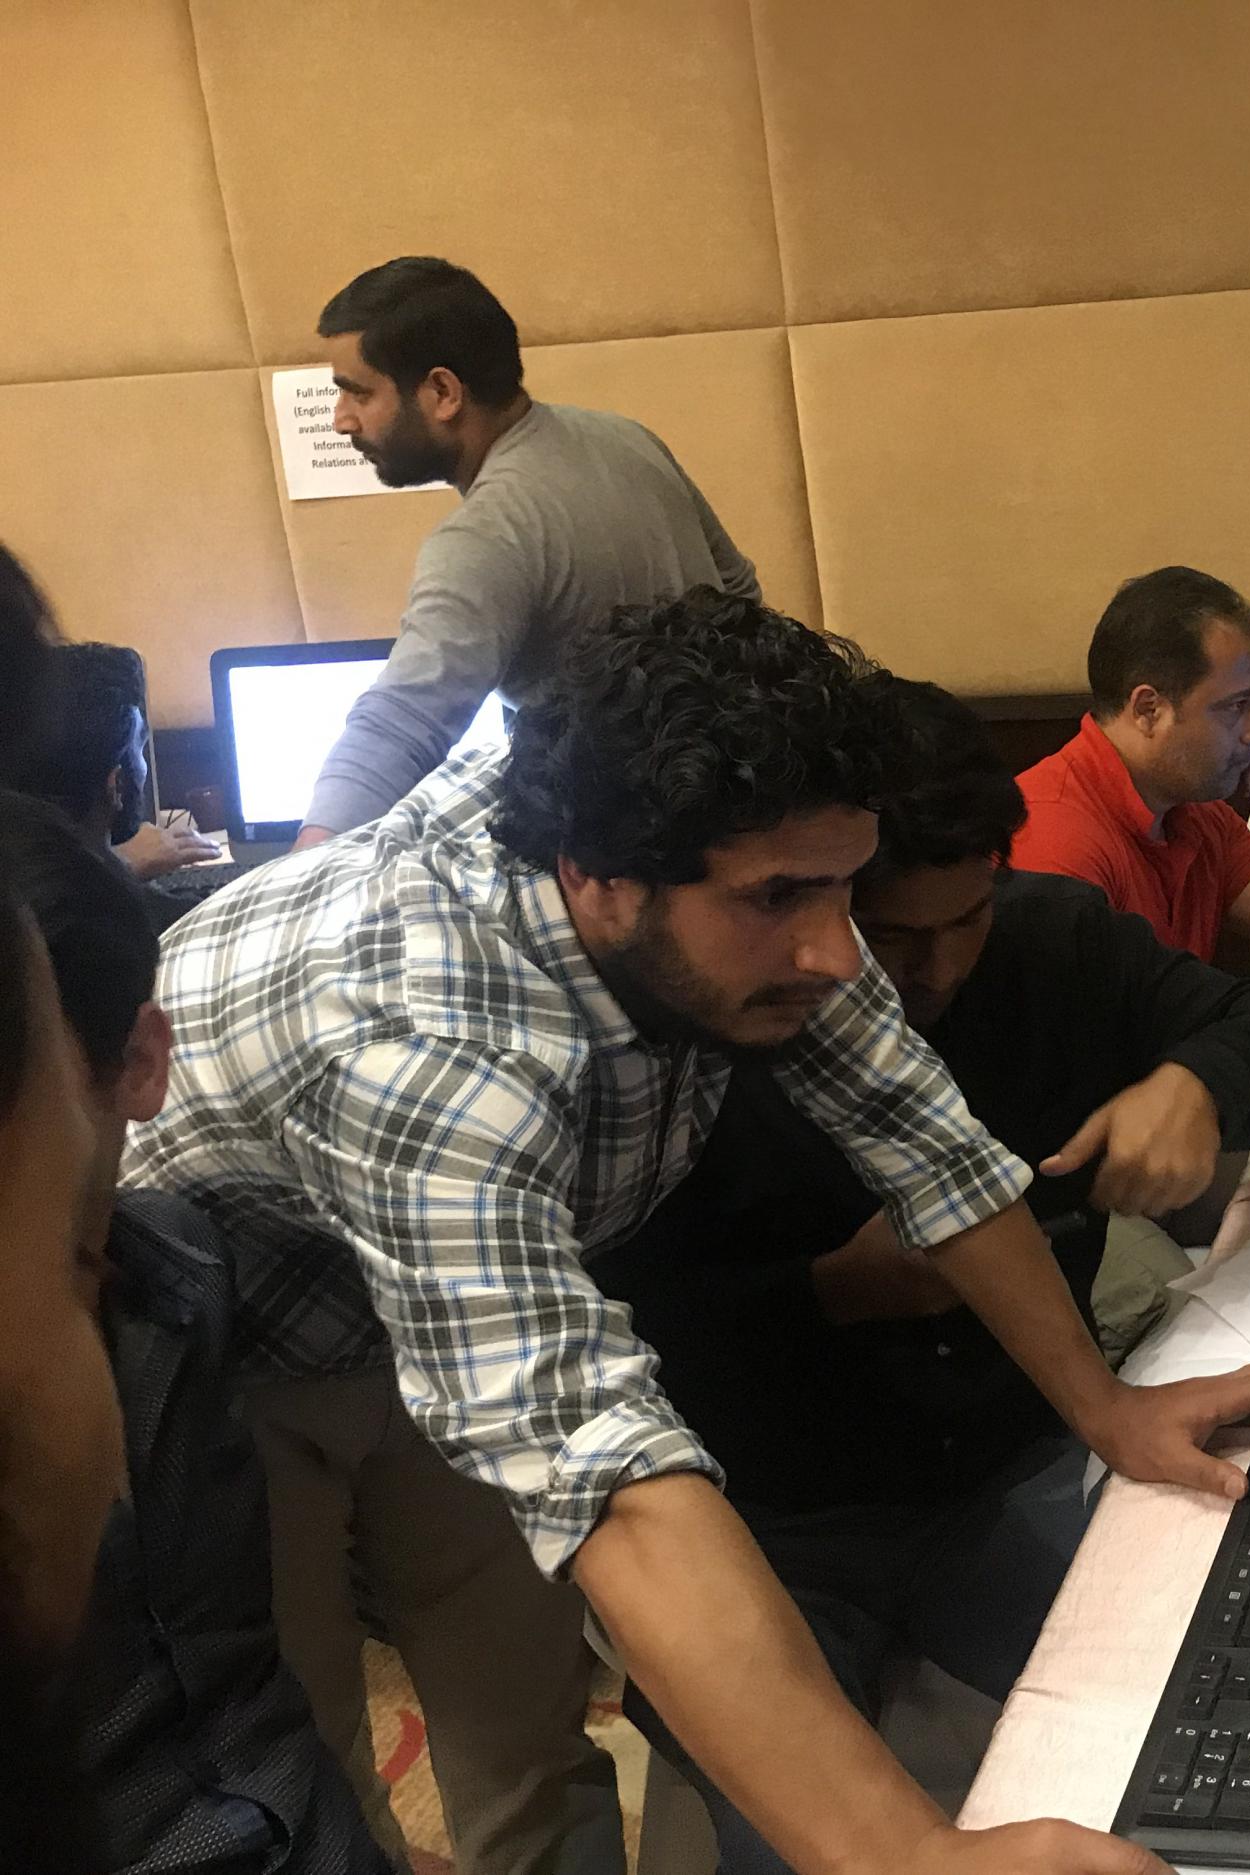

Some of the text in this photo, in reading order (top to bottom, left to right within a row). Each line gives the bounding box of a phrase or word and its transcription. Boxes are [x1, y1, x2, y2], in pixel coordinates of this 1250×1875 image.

[296, 388, 313, 399] Full
[294, 404, 331, 418] (English
[298, 422, 337, 434] availabl
[313, 440, 352, 450] Informa
[311, 457, 356, 469] Relations
